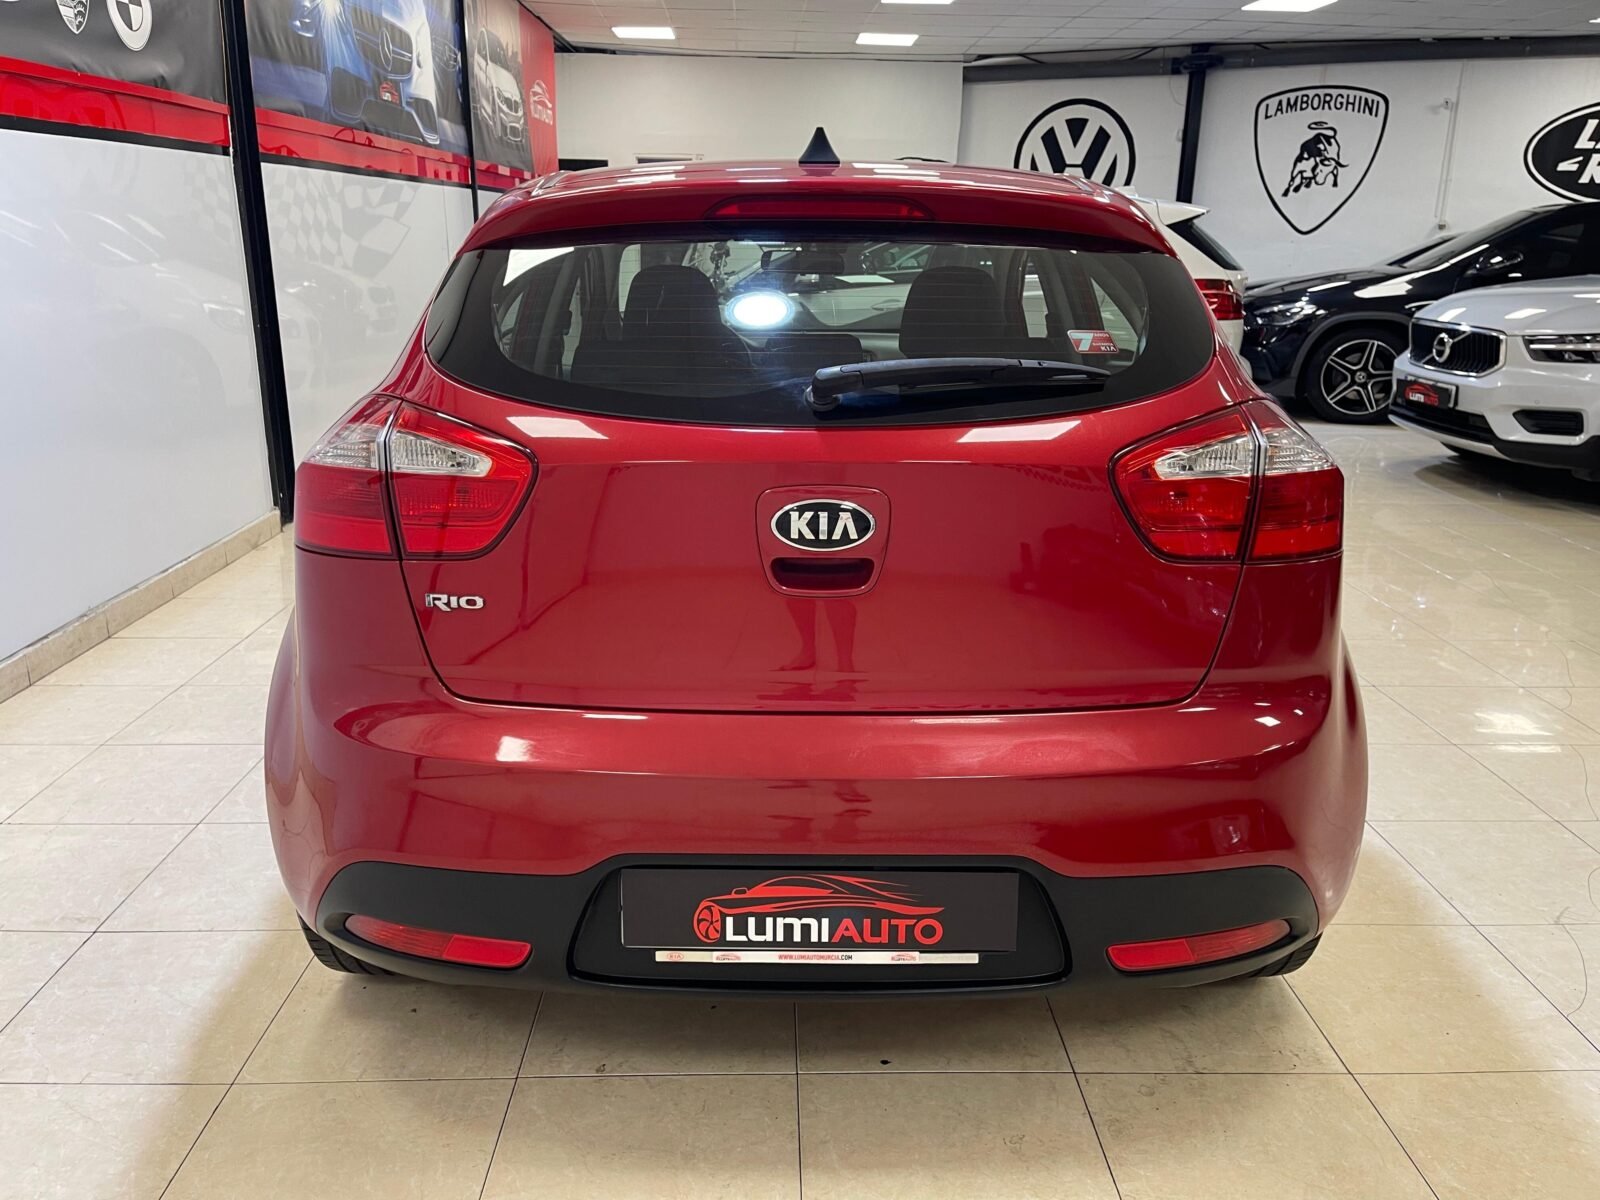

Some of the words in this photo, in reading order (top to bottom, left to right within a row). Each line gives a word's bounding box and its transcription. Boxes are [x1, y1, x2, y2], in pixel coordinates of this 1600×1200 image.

[1264, 93, 1380, 120] LAMBORGHINI
[789, 511, 859, 540] KIA
[425, 593, 484, 611] RIO
[726, 917, 944, 945] LUMIAUTO
